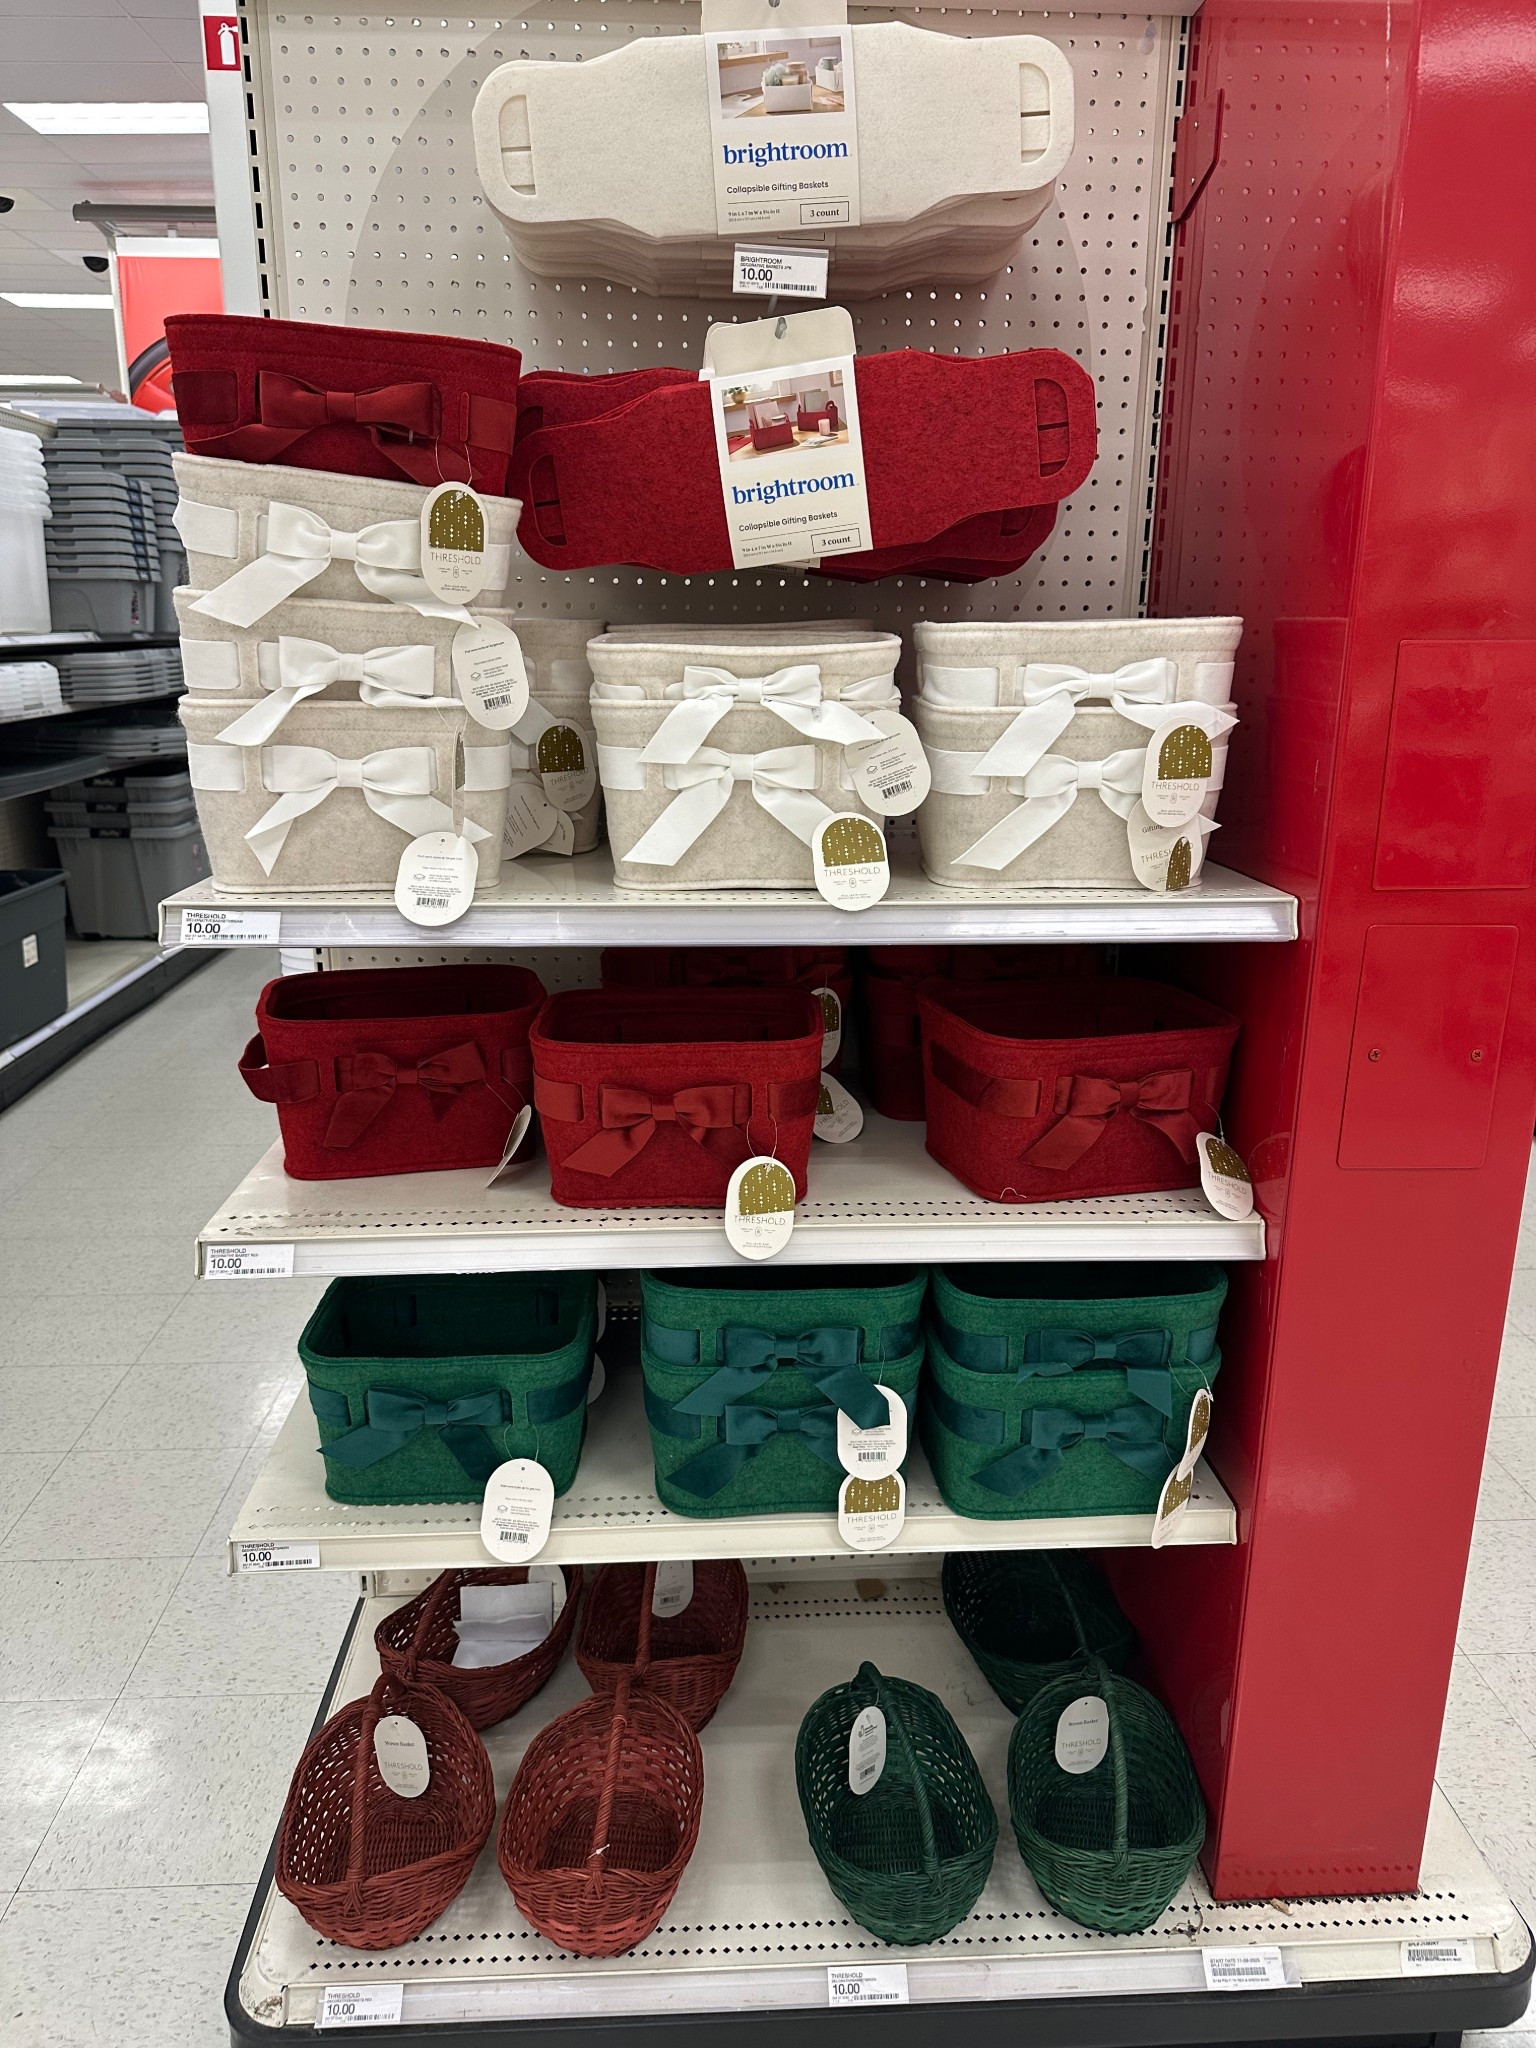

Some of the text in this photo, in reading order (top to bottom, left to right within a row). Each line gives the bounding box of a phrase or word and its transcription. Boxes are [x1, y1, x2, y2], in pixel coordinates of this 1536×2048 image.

[723, 142, 848, 167] brightroom
[727, 181, 829, 194] Collapsible Gifting Baskets
[816, 208, 840, 217] count
[741, 256, 782, 264] BRIGHTROOM
[741, 268, 773, 281] 10.00
[731, 472, 855, 505] brightroom
[738, 511, 838, 531] Collapsible Gifting Baskets
[828, 536, 851, 545] count
[430, 552, 481, 565] THRESHOLD
[550, 768, 588, 786] THRESHOLD
[1151, 781, 1200, 791] THRESHOLD
[824, 867, 881, 877] THRESHOLD
[187, 923, 221, 933] 10.00
[1208, 1171, 1247, 1195] THRESHOLD
[734, 1215, 786, 1226] THRESHOLD
[211, 1258, 242, 1269] 10.00
[846, 1512, 897, 1523] THRESHOLD
[243, 1552, 272, 1562] 10.00
[1061, 1738, 1102, 1749] THRESHOLD
[384, 1761, 423, 1771] THRESHOLD
[833, 1983, 860, 1995] 10.00
[328, 2003, 356, 2016] 10.00
